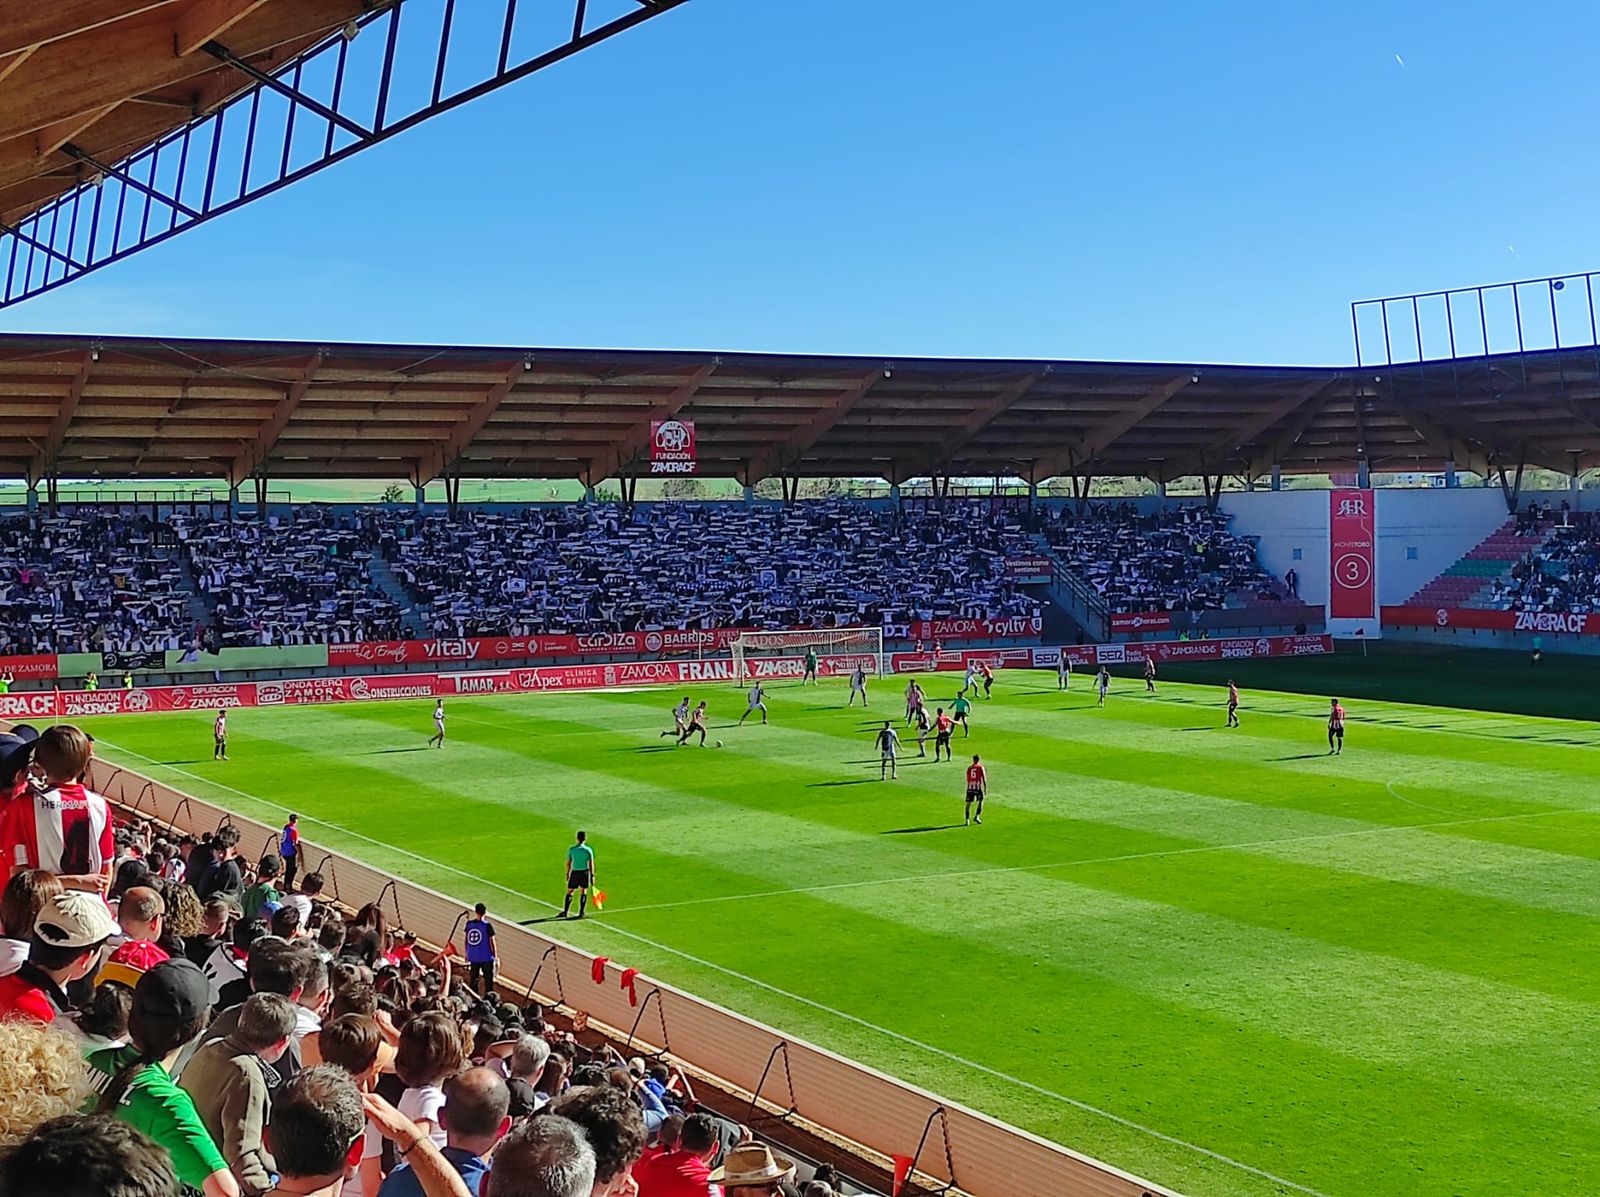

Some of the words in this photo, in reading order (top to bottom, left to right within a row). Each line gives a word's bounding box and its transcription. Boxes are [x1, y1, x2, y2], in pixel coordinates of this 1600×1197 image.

[1346, 562, 1359, 581] 3
[934, 620, 978, 634] ZAMORA
[995, 619, 1026, 637] cyltv
[1567, 614, 1588, 633] CF
[1293, 645, 1325, 654] ZAMORA
[18, 664, 57, 673] ZAMORA
[565, 669, 598, 678] CLÍNICA
[620, 664, 673, 678] ZAMORA
[284, 681, 313, 690] ONDA
[314, 678, 344, 689] CERO
[567, 677, 598, 685] DENTAL
[65, 691, 121, 705] FUNDACIÓN
[284, 687, 344, 698] ZAMORA
[31, 696, 55, 714] CF
[189, 696, 242, 709] ZAMORA
[971, 768, 978, 779] 6
